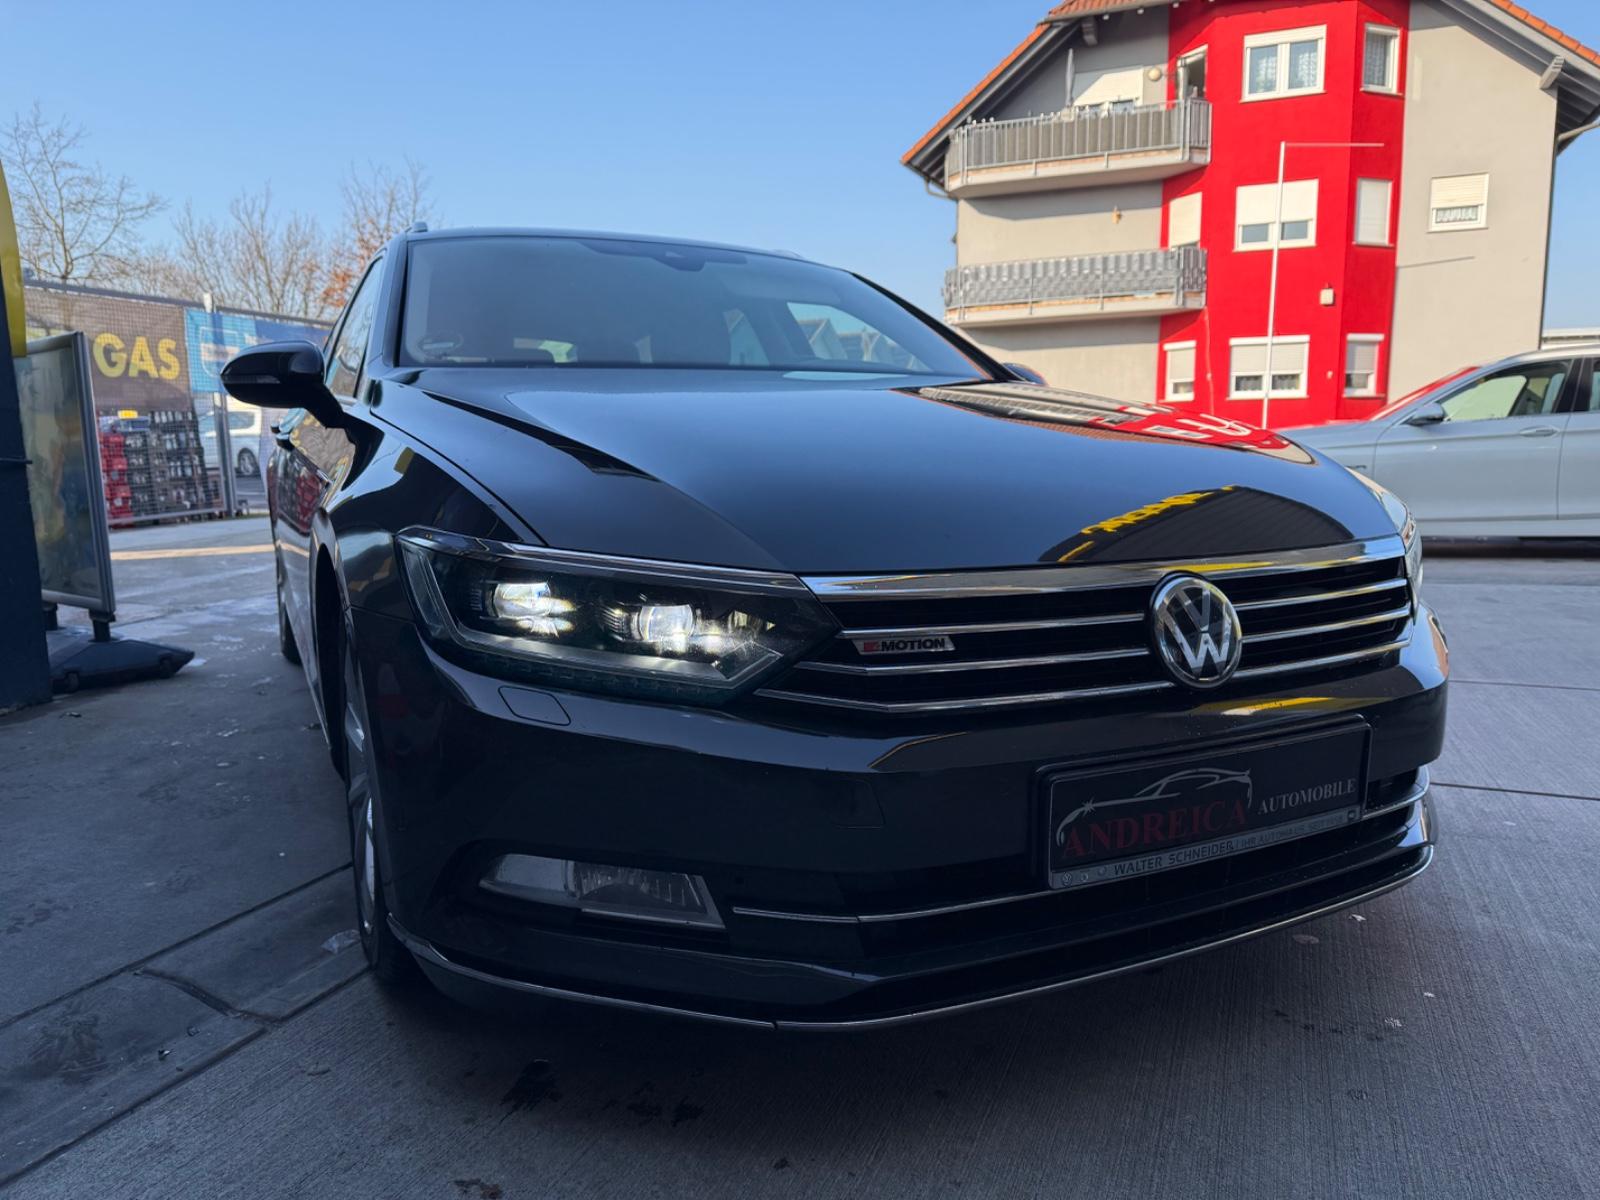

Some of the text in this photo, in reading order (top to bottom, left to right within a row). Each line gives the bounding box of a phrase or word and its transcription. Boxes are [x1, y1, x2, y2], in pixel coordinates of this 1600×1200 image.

[93, 332, 180, 380] GAS
[1158, 582, 1236, 682] VW
[1062, 778, 1357, 858] ANDREICA AUTOMOBILE
[1113, 856, 1162, 876] WALTER
[1168, 841, 1233, 865] SCHNEIDER
